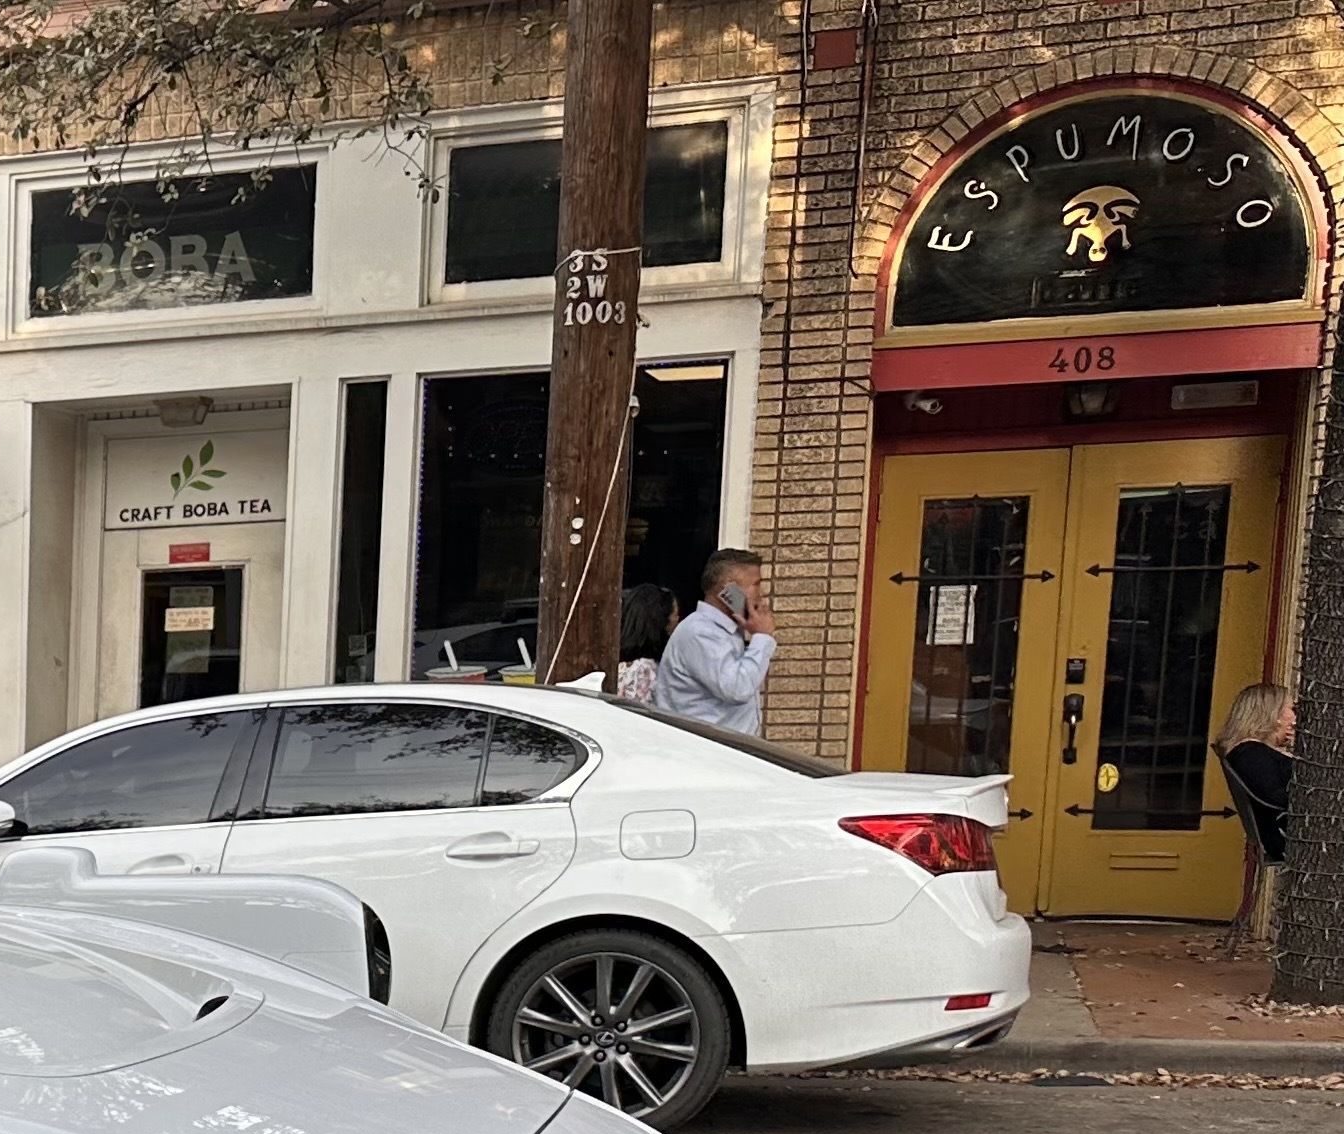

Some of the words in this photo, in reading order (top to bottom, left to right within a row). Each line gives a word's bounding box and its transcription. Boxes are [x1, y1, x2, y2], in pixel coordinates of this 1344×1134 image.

[927, 114, 1274, 252] ESPUMOSO
[78, 230, 258, 295] BOBA
[563, 300, 627, 326] 1003
[1048, 346, 1115, 373] 408
[119, 506, 174, 523] CRAFT
[183, 502, 230, 519] BOBA
[238, 499, 272, 514] TEA
